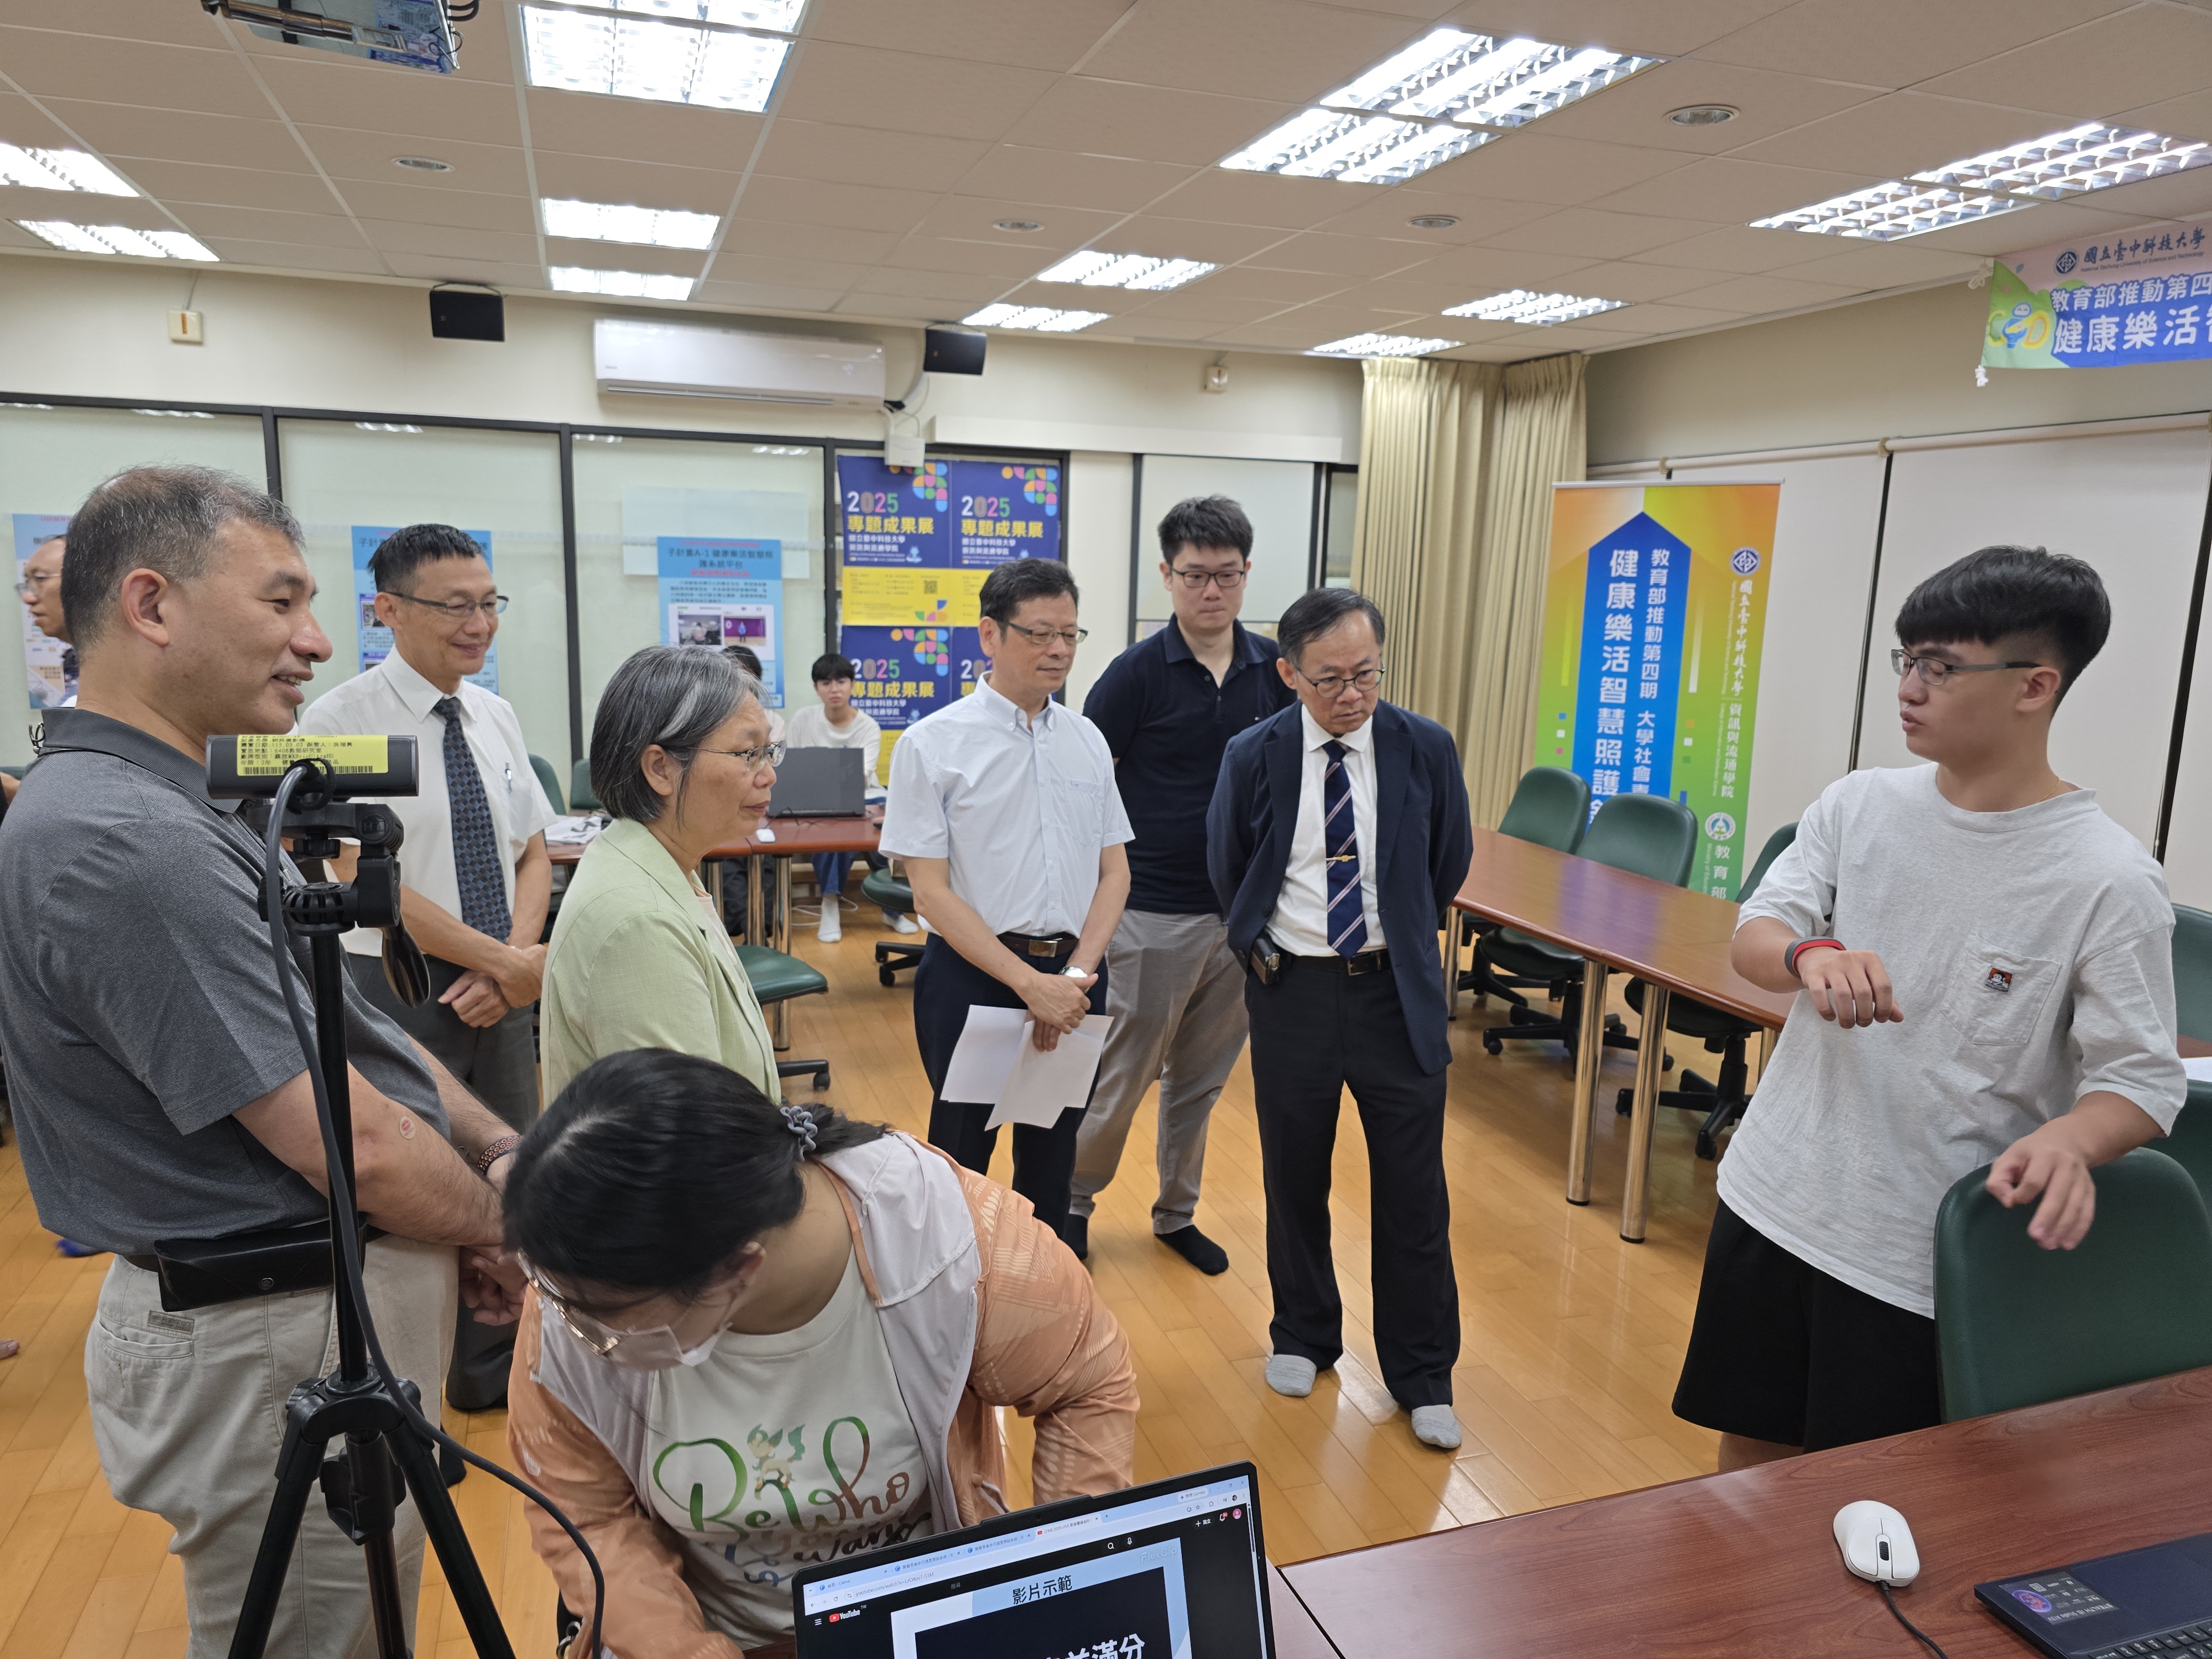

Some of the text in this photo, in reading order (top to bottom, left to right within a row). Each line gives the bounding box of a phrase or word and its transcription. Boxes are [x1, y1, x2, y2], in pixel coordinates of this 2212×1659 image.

[2052, 305, 2212, 355] 健康樂活
[847, 491, 899, 514] 2025
[961, 495, 1010, 518] 2025
[847, 515, 934, 535] 專題成果展
[961, 519, 1044, 538] 專題成果展
[1640, 549, 1670, 699] 教育部推動第四期
[851, 658, 900, 680] 2025
[961, 659, 992, 680] 20
[1720, 703, 1742, 798] 資訊與流通學院
[1711, 844, 1731, 900] 教育部
[1140, 1546, 1178, 1564] FlexClip
[1013, 1574, 1073, 1605] 影片示範
[839, 1608, 860, 1620] YouTube
